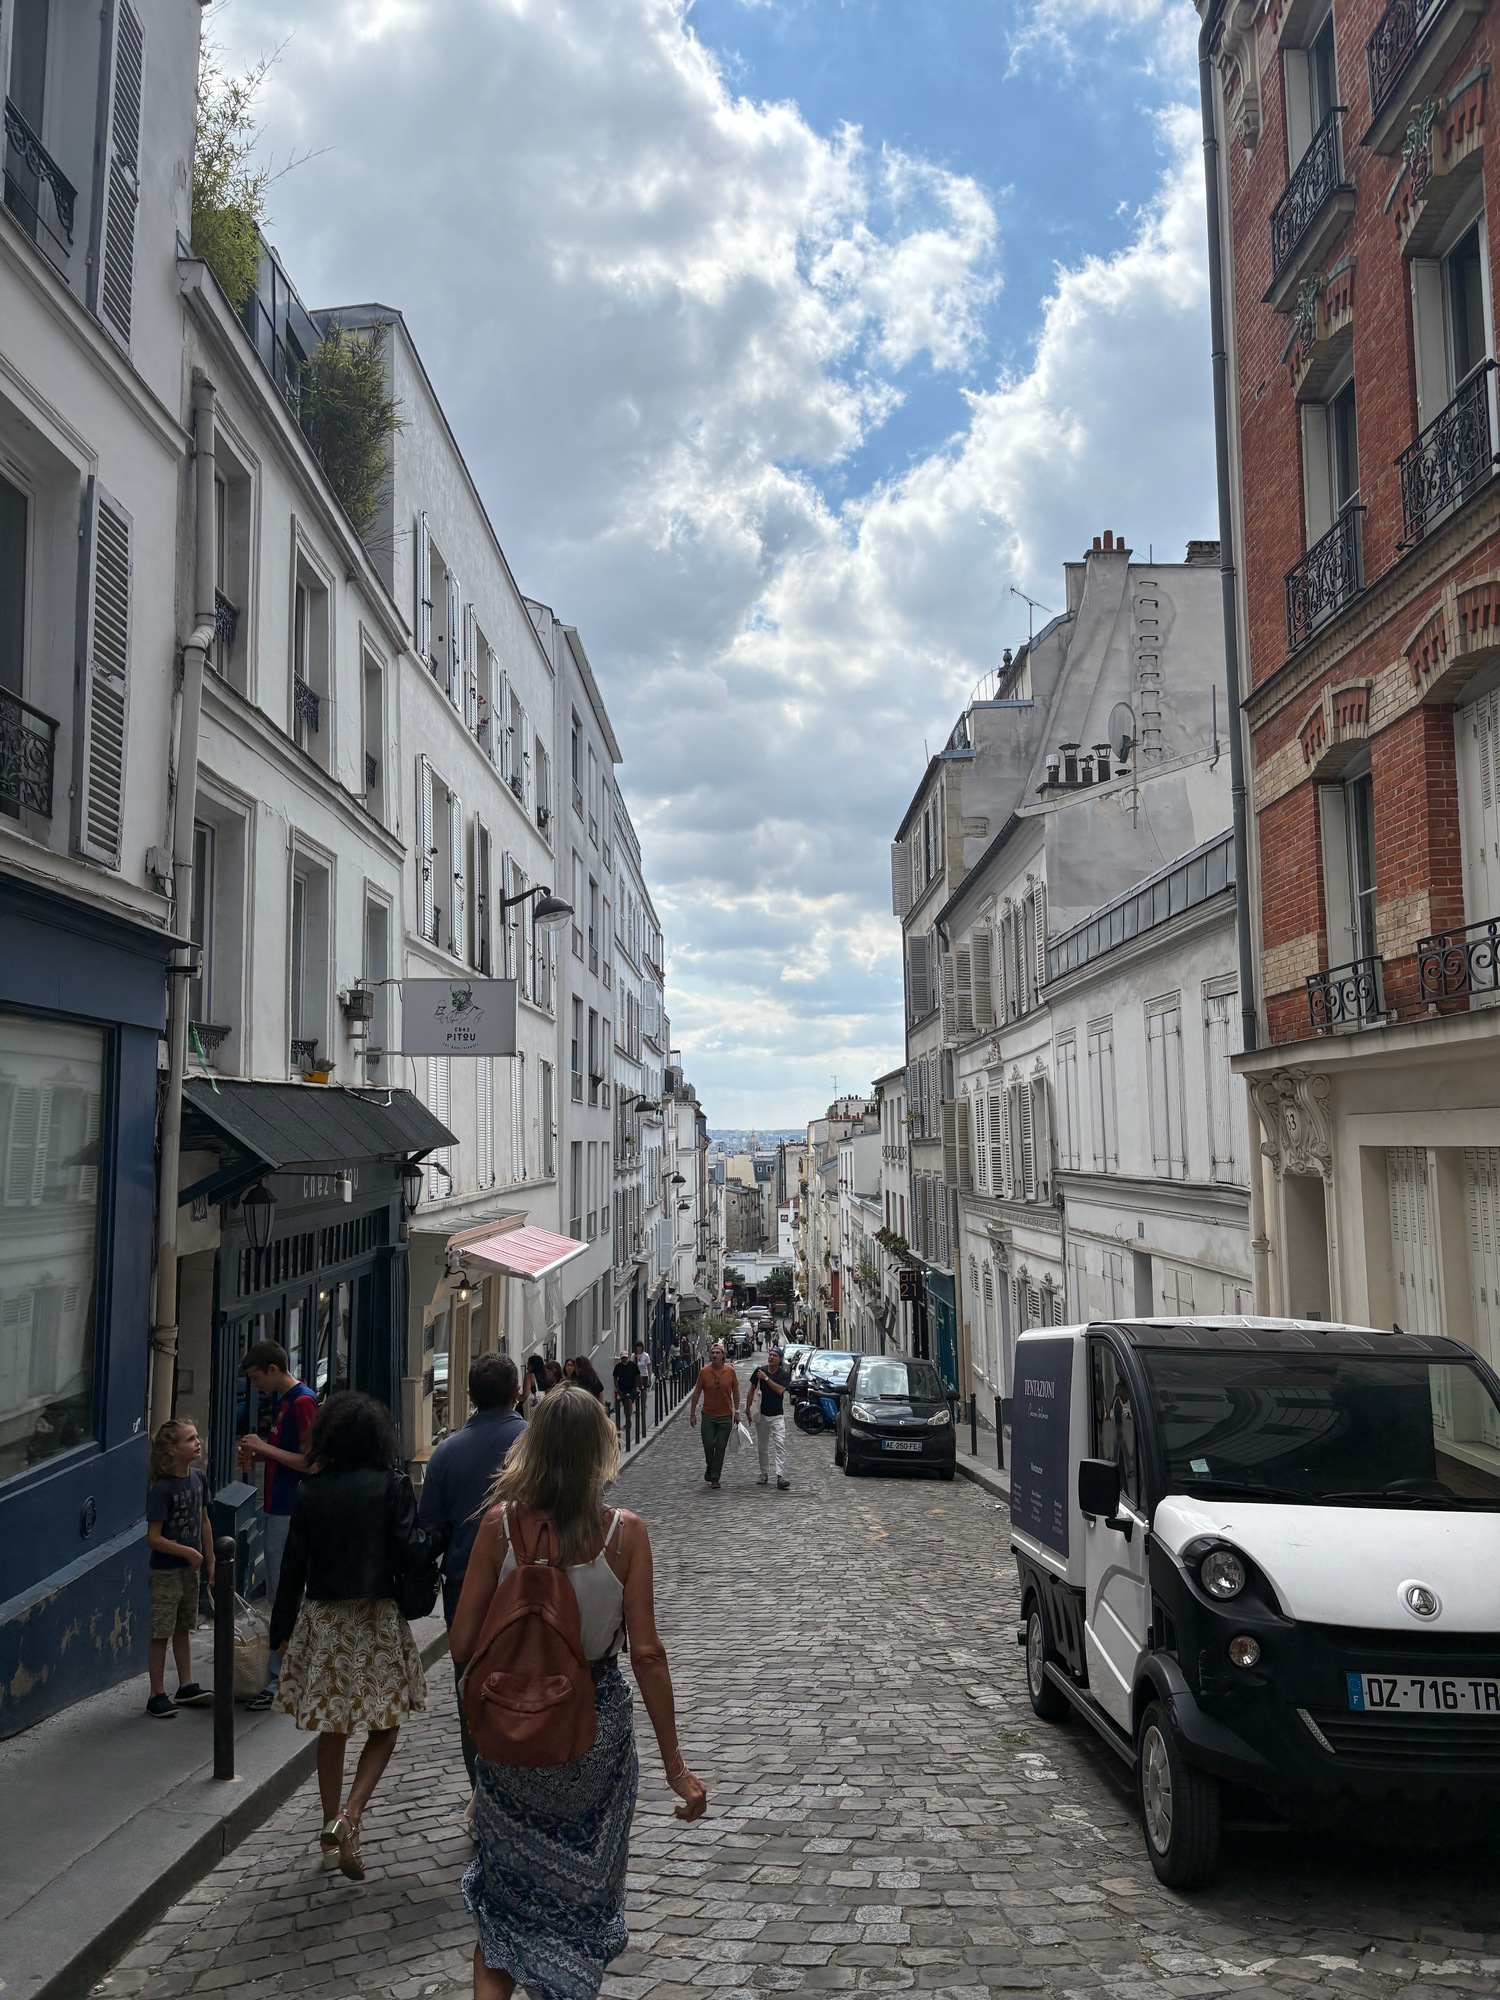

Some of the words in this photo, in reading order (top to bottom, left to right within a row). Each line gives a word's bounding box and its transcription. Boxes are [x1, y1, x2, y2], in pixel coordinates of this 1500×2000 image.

[446, 1033, 476, 1041] PITOU
[1286, 1114, 1296, 1130] 33
[304, 1175, 329, 1198] Chez
[194, 1194, 205, 1214] 28
[900, 1283, 917, 1297] 21
